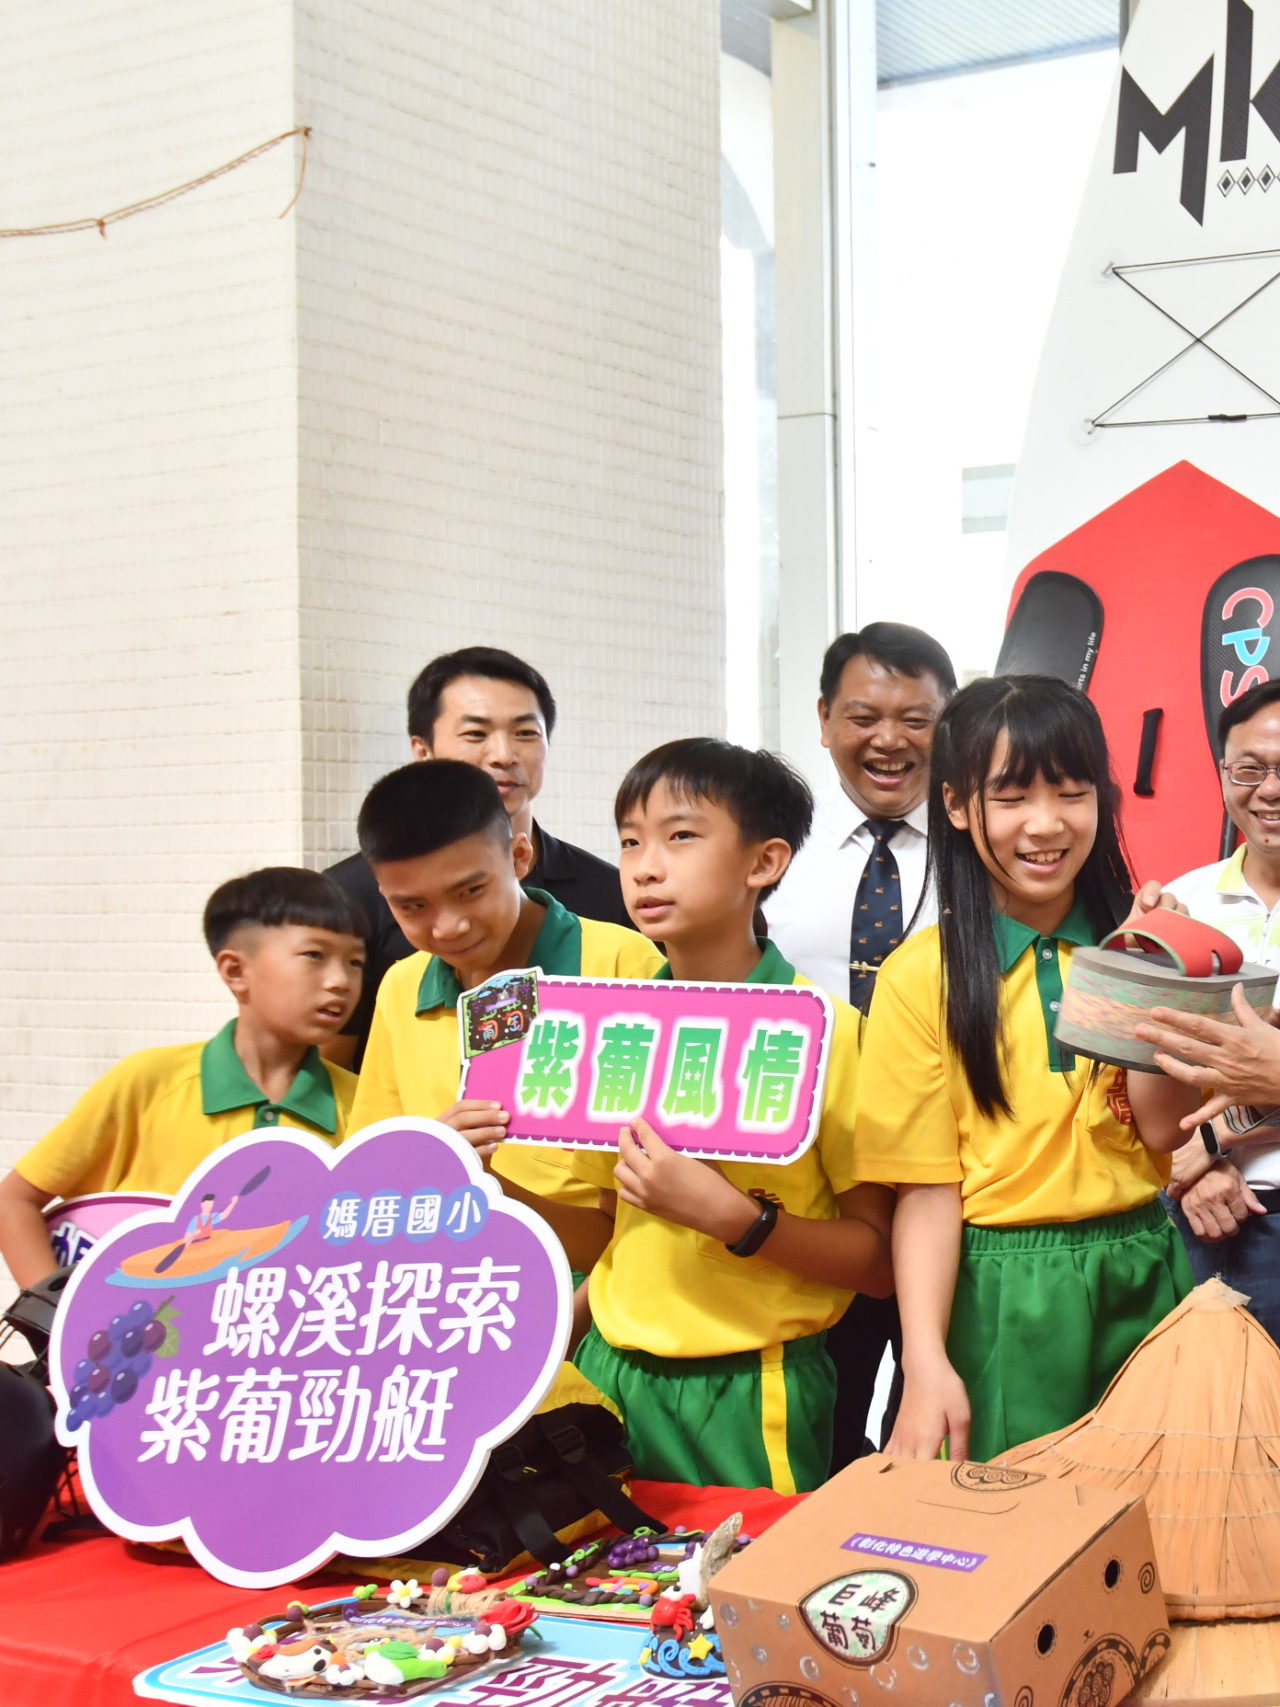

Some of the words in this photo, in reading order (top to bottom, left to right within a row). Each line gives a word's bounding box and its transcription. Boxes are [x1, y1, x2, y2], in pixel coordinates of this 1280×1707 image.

[1085, 647, 1094, 662] my
[1087, 632, 1097, 646] life
[520, 1019, 805, 1123] 紫葡風情
[323, 1191, 482, 1239] 媽厝國小
[202, 1257, 521, 1358] 螺溪探索
[137, 1364, 459, 1464] 紫葡勁艇
[828, 1585, 900, 1612] 巨峰
[820, 1611, 876, 1651] 葡萄
